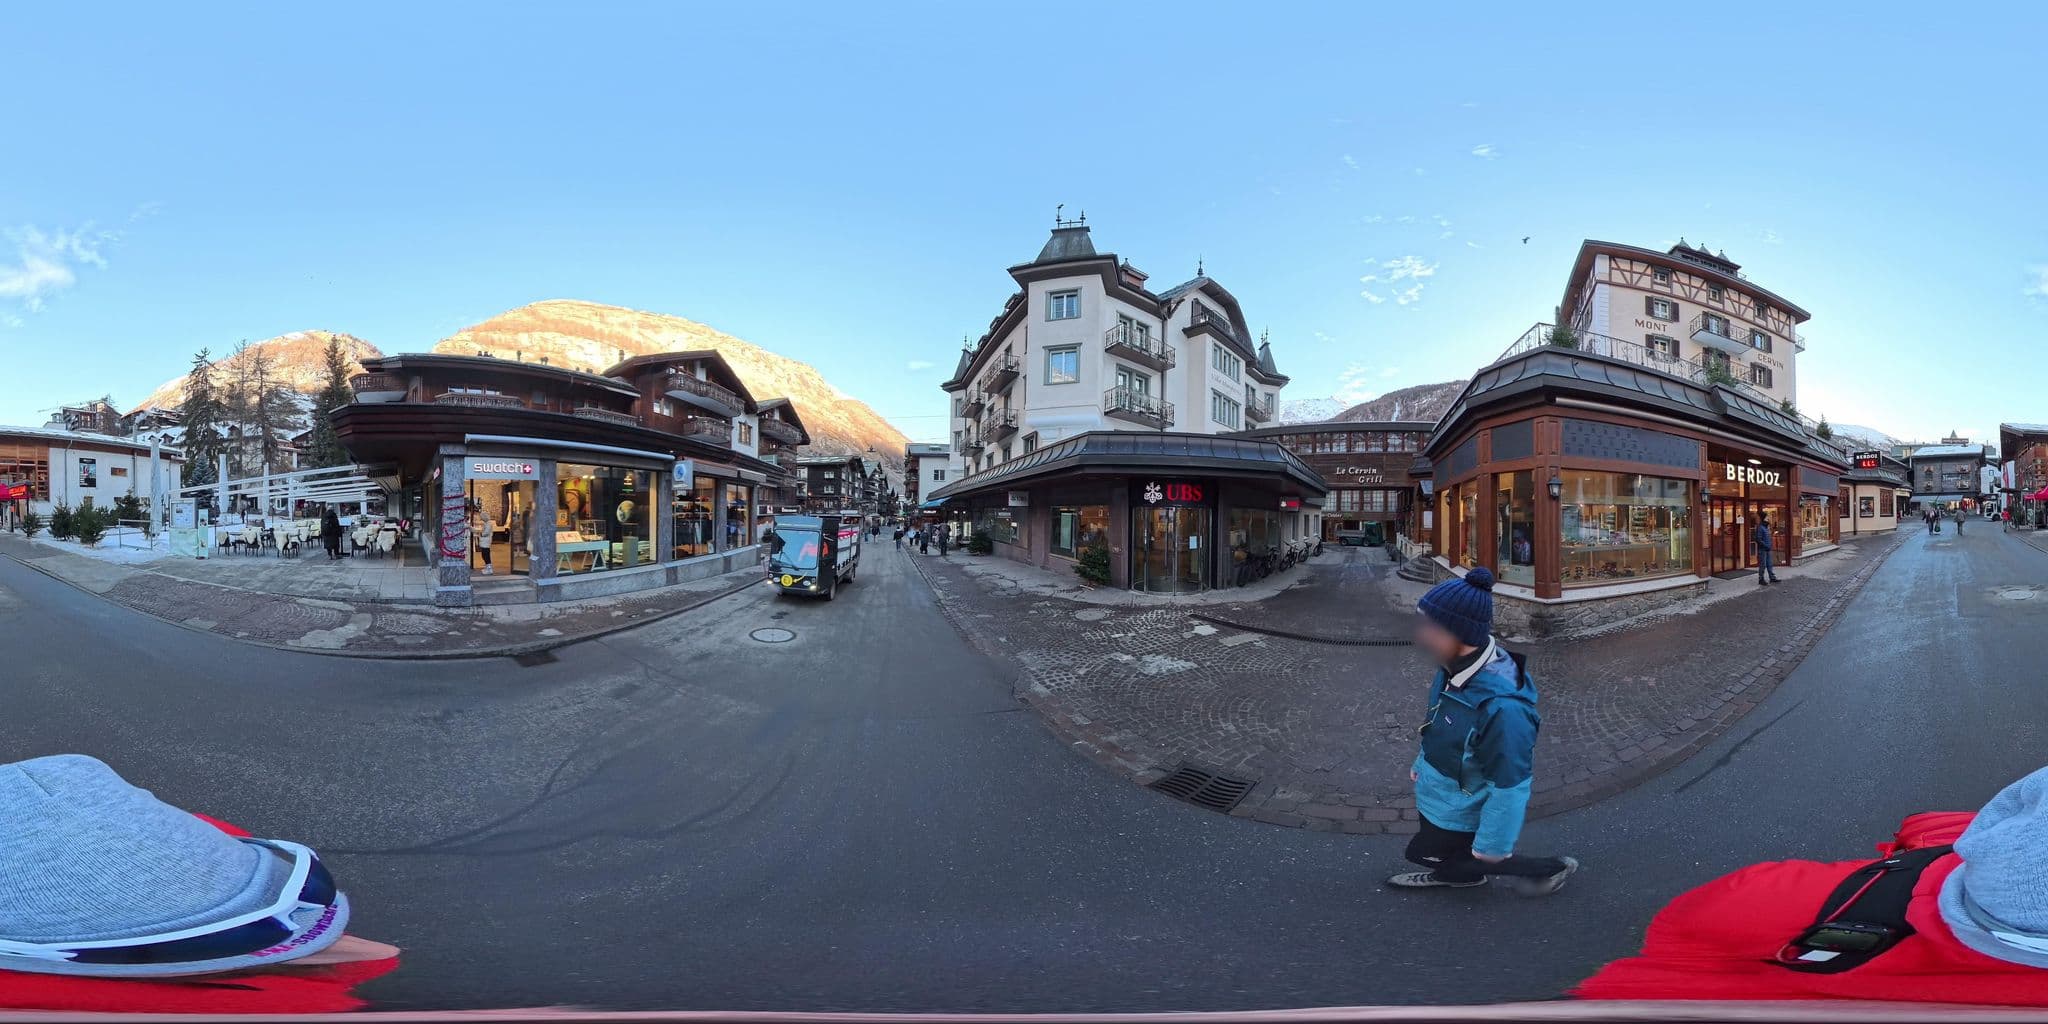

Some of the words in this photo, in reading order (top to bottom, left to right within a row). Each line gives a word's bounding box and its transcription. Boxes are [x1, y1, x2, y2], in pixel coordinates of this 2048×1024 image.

[1634, 318, 1668, 333] MONT
[1757, 353, 1785, 371] CERVIN
[473, 462, 524, 473] swatch
[1336, 467, 1346, 475] Le
[1348, 466, 1377, 475] Cervin
[1726, 463, 1780, 487] BERDOZ
[1358, 475, 1383, 484] Grill
[1167, 484, 1202, 502] UBS
